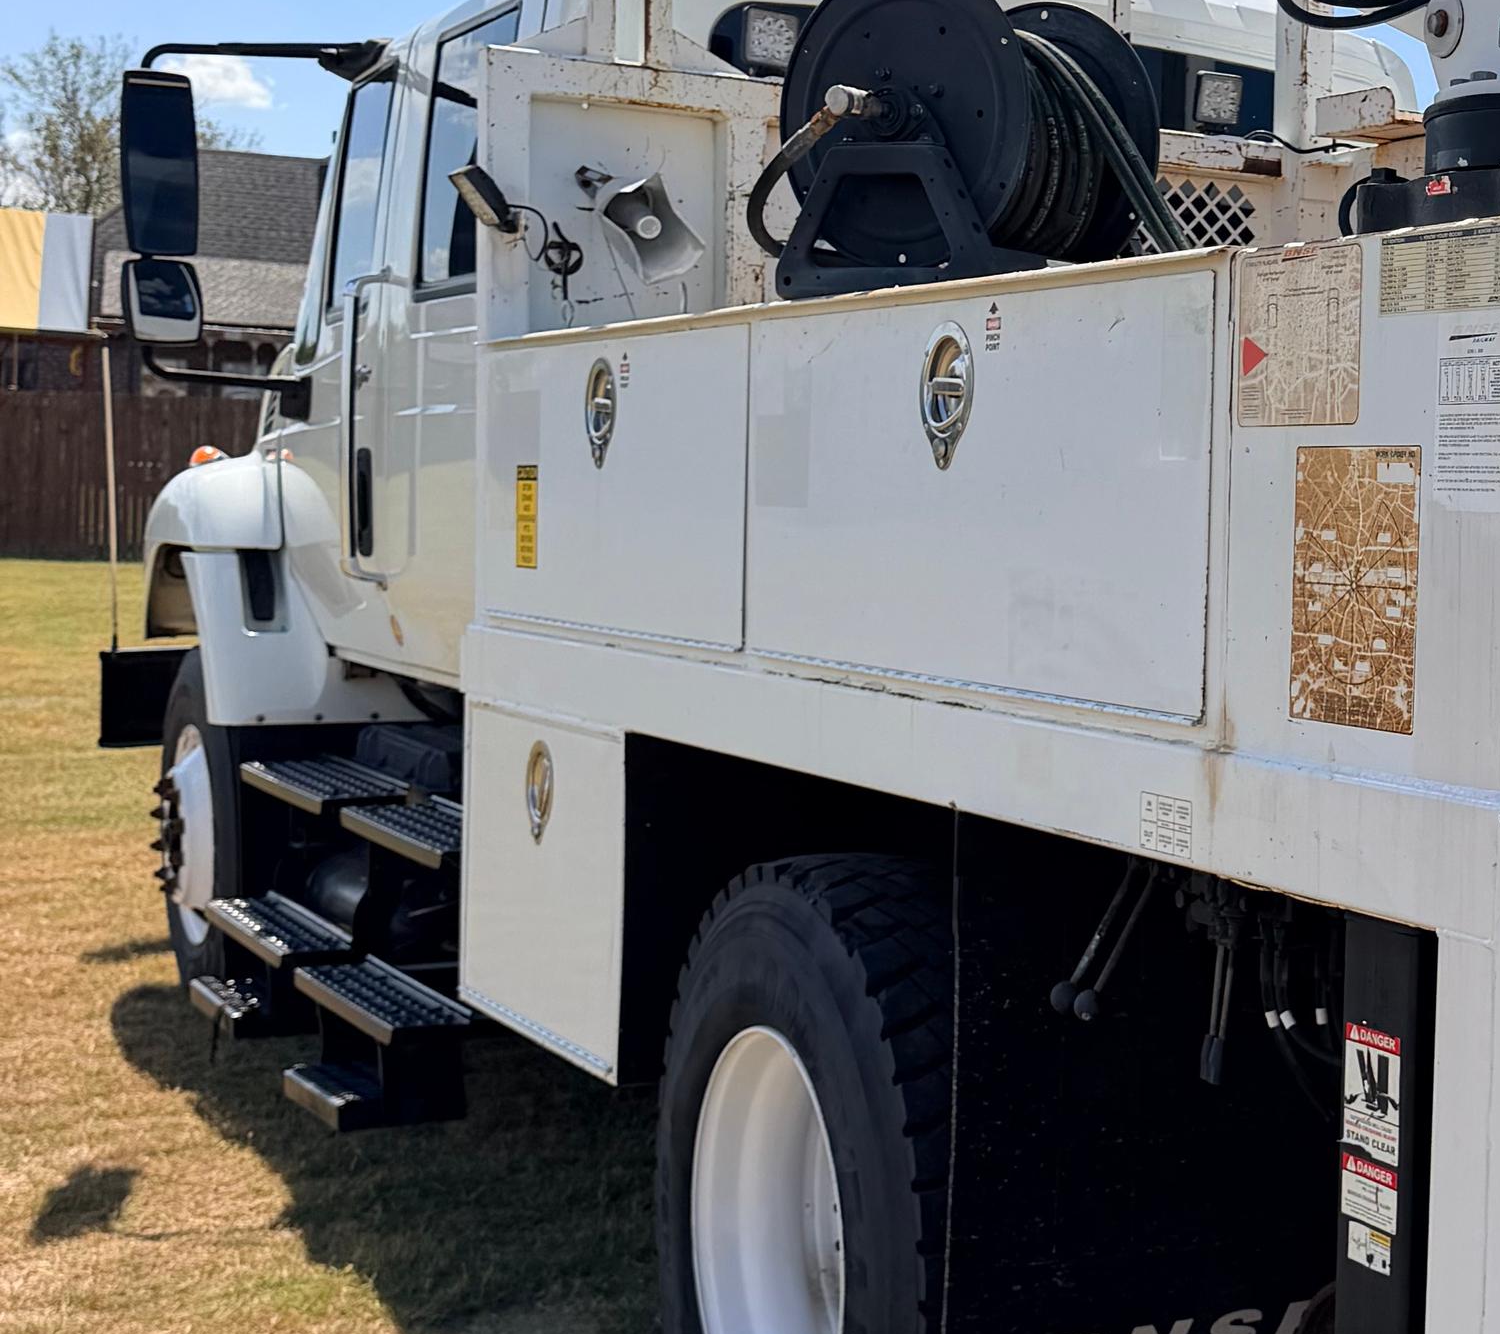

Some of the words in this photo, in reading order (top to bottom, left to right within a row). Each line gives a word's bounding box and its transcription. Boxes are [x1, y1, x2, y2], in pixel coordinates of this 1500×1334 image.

[1284, 246, 1319, 257] BNSF
[1359, 1027, 1396, 1050] DANGER
[1346, 1129, 1370, 1146] STAND
[1371, 1138, 1396, 1155] CLEAR
[1356, 1160, 1393, 1186] DANGER
